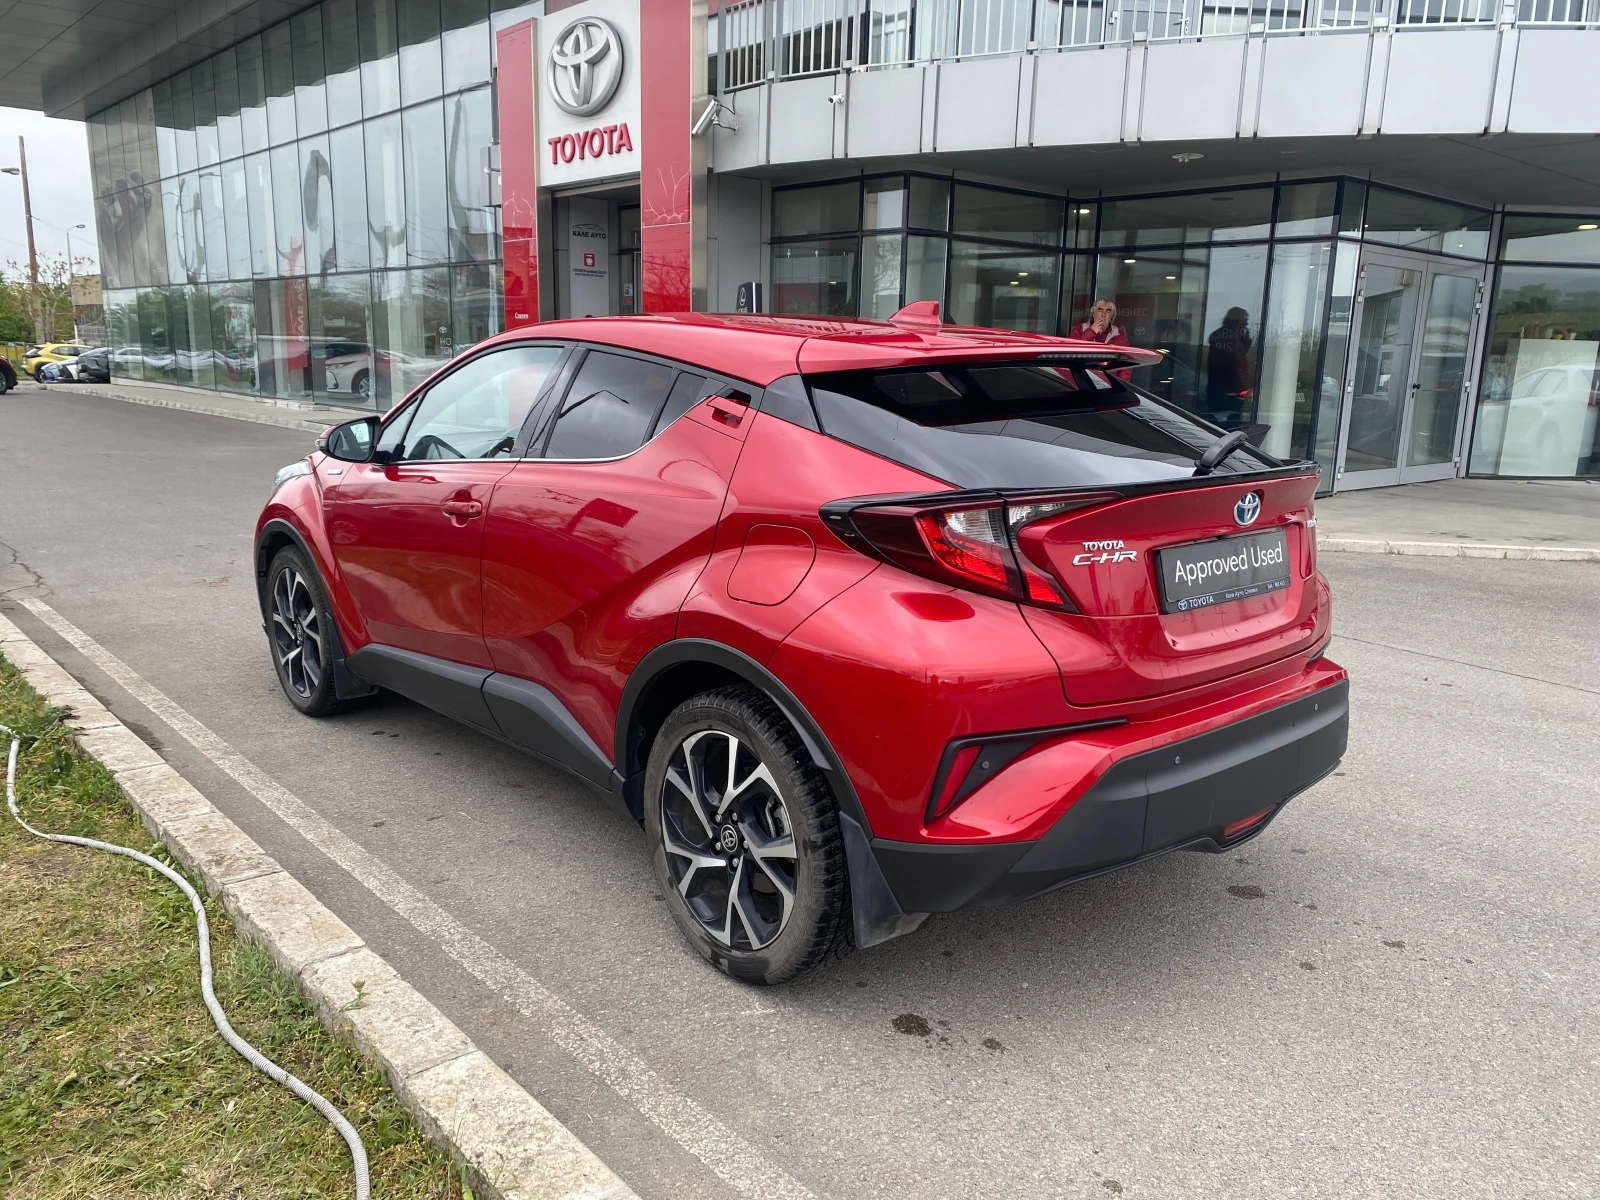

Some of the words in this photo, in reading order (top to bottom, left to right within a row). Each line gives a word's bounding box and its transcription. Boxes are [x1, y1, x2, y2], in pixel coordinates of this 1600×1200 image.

[548, 122, 633, 165] TOYOTA
[1082, 540, 1125, 550] TOYOTA
[1072, 551, 1137, 566] C-HR
[1175, 547, 1248, 586] Approved
[1250, 541, 1283, 567] Used
[1189, 595, 1214, 608] TOYOTA
